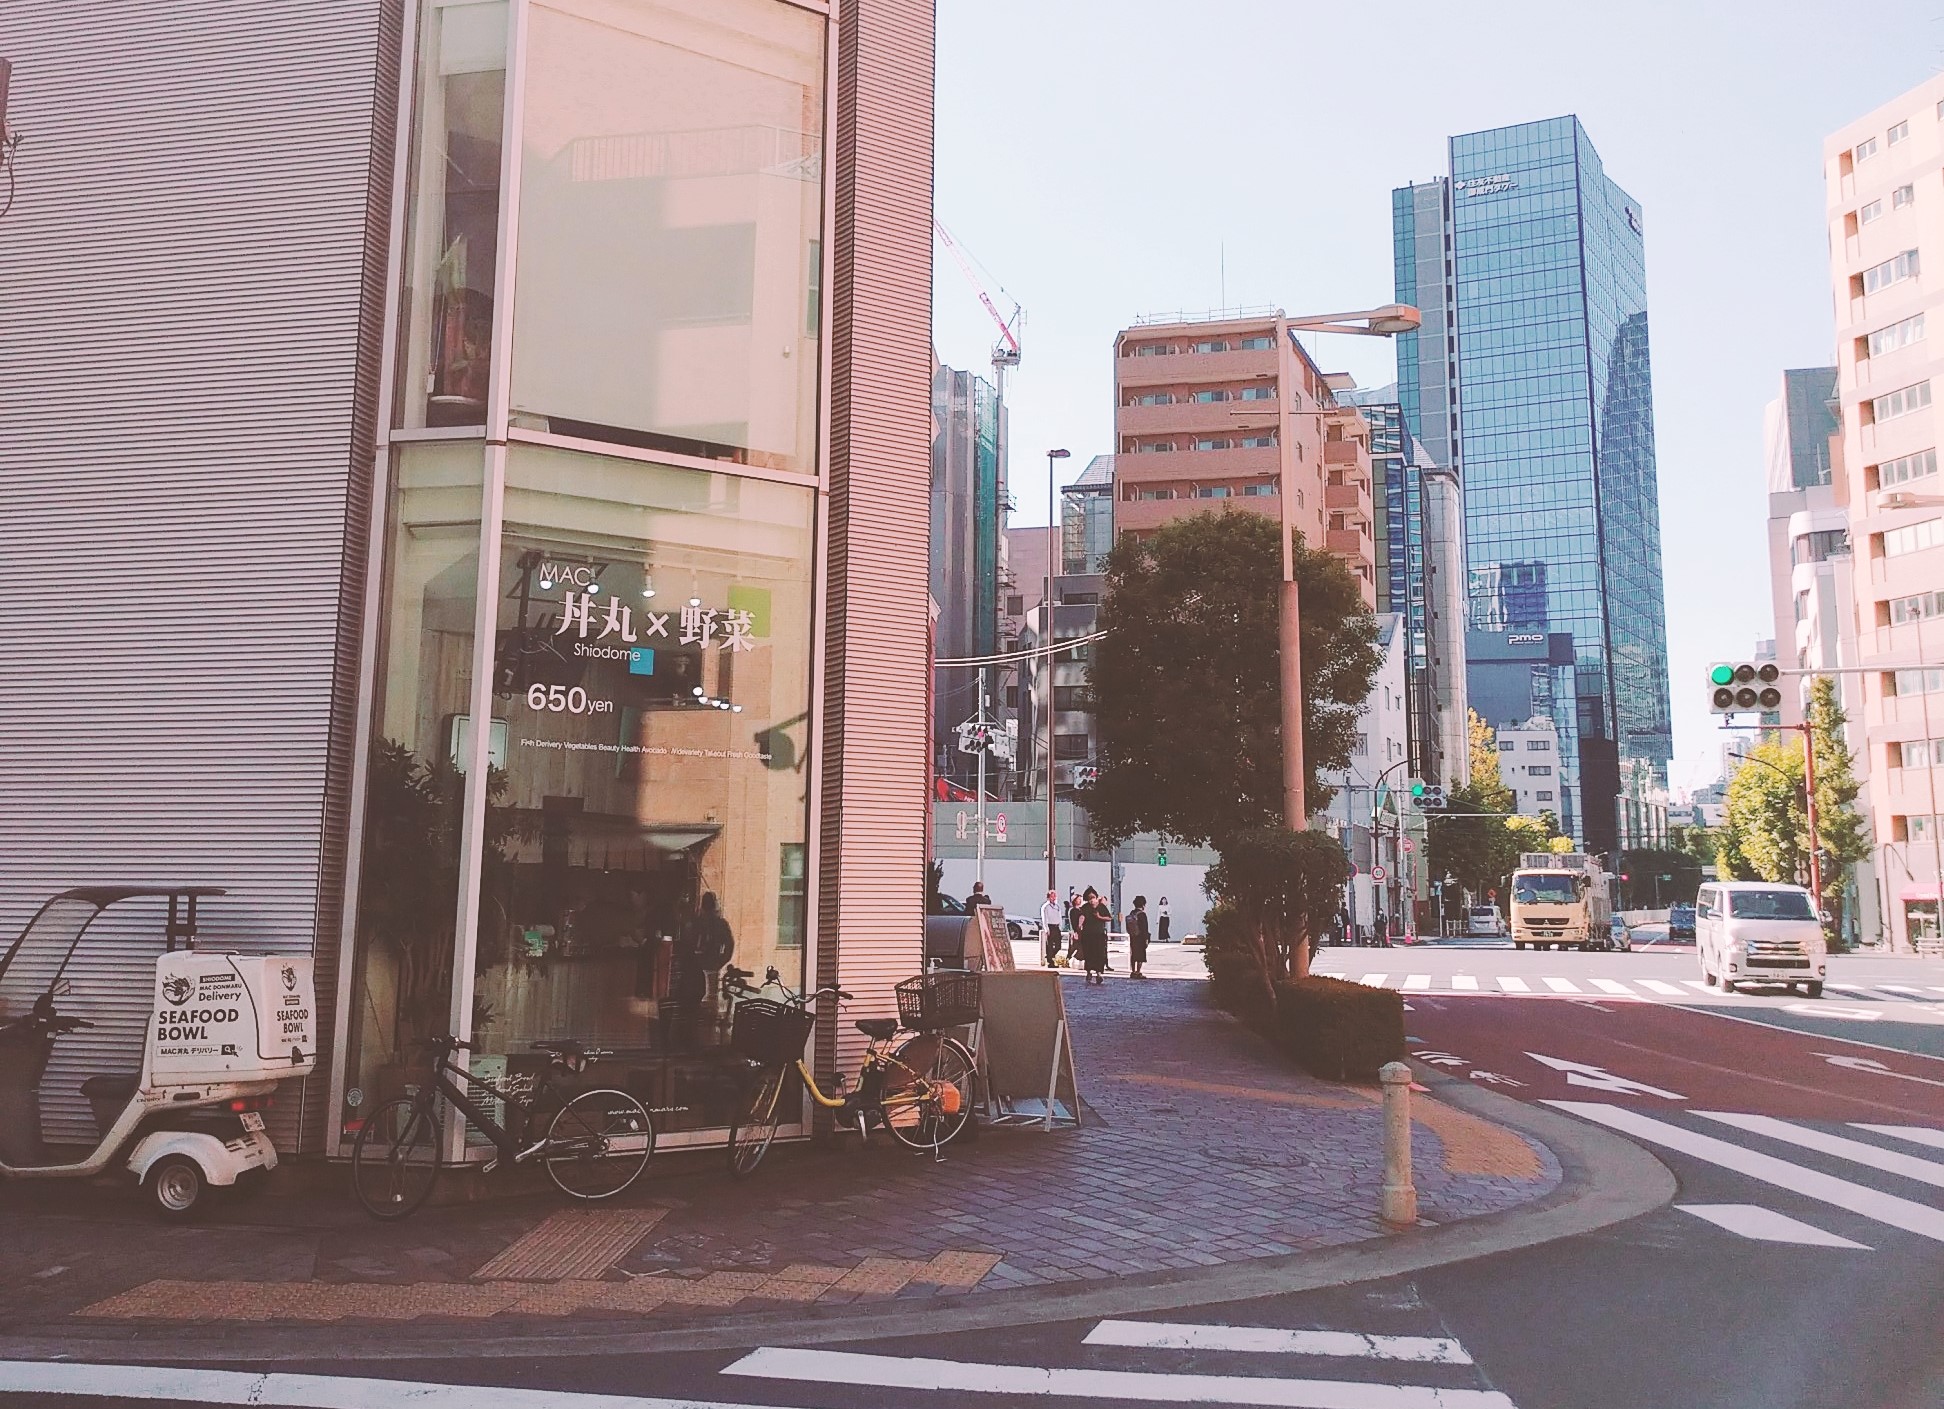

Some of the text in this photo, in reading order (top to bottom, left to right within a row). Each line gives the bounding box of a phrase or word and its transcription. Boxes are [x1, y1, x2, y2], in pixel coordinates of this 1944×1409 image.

[573, 642, 641, 662] Shiodome
[563, 741, 598, 751] Vegetables
[598, 743, 620, 753] Beauty
[199, 990, 242, 1002] Delivery
[158, 1008, 239, 1025] SEAFOOD
[277, 1009, 309, 1021] SEAFOOD
[157, 1026, 208, 1041] BOWL
[283, 1022, 304, 1034] BOWL
